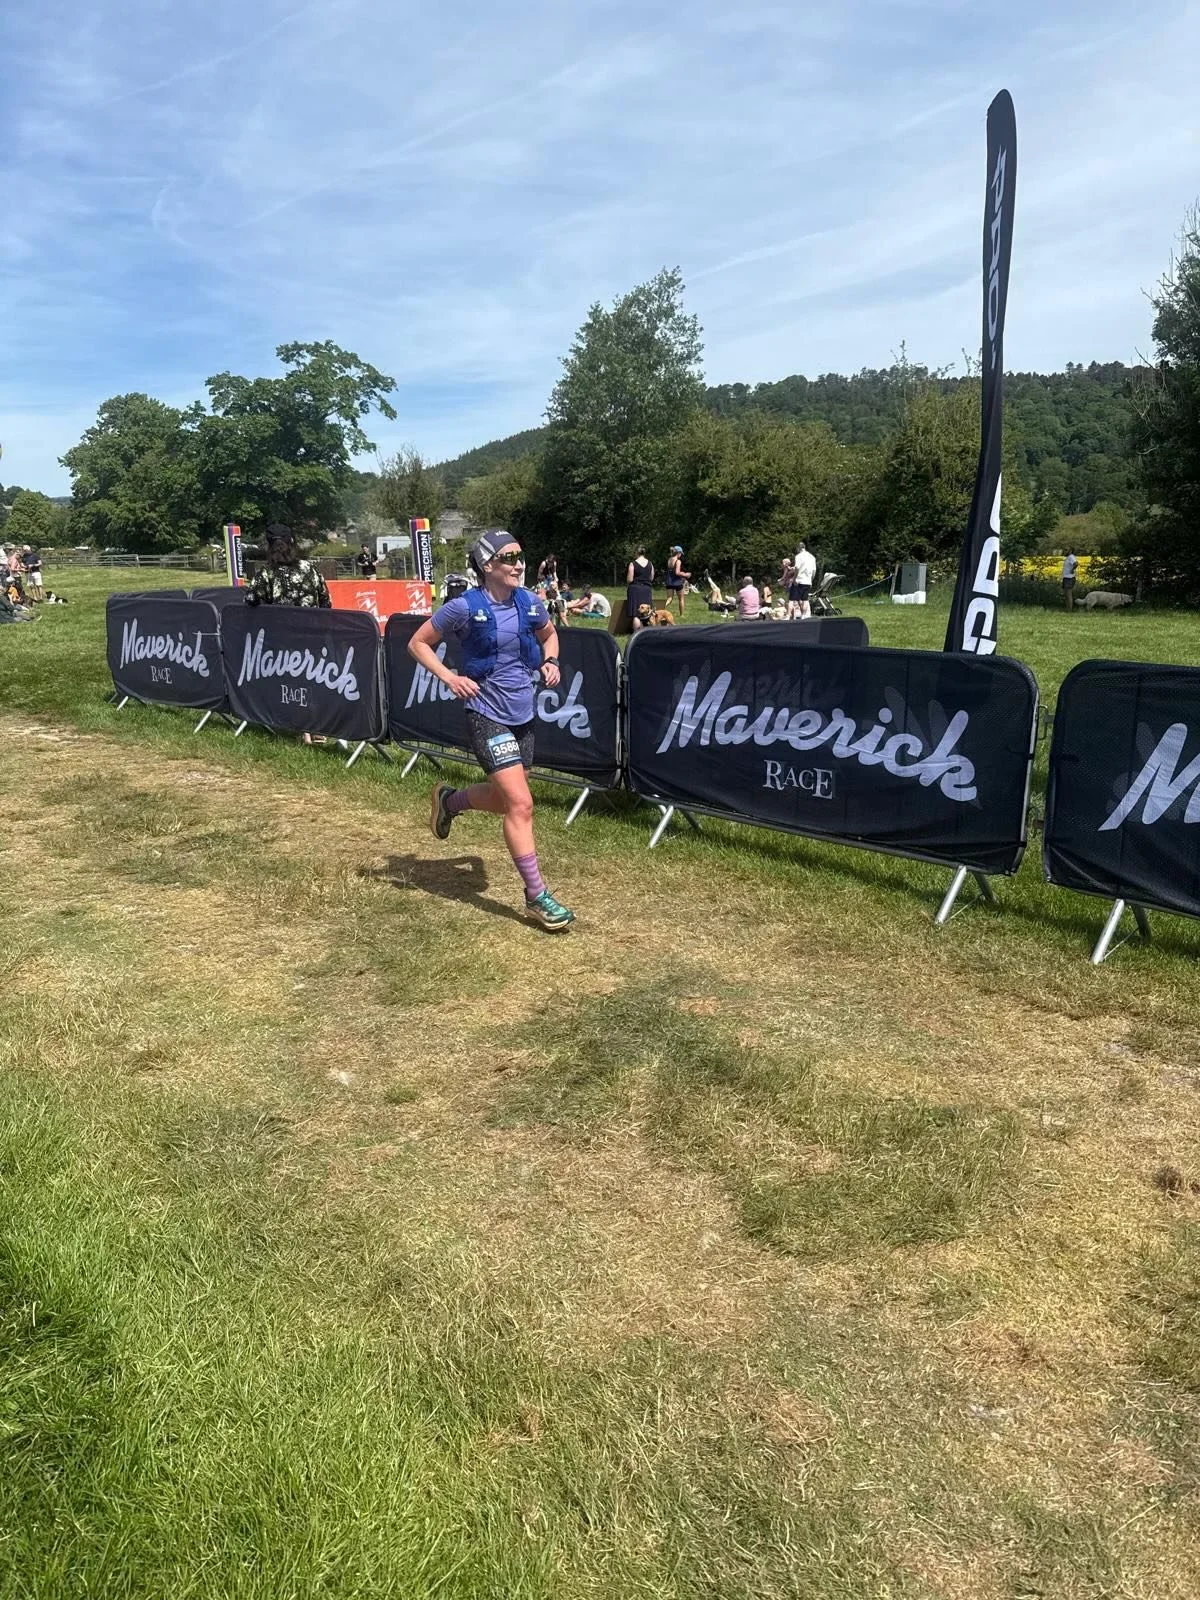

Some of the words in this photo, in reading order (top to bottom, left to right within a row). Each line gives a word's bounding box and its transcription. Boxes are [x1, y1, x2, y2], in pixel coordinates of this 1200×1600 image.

[421, 534, 432, 582] PRECISION
[120, 618, 210, 677] Maverick
[237, 628, 360, 700] Maverick
[151, 665, 173, 684] RACE
[281, 684, 308, 707] RACE
[405, 641, 591, 738] Mack
[656, 671, 978, 801] Maverick
[763, 759, 833, 799] RACE
